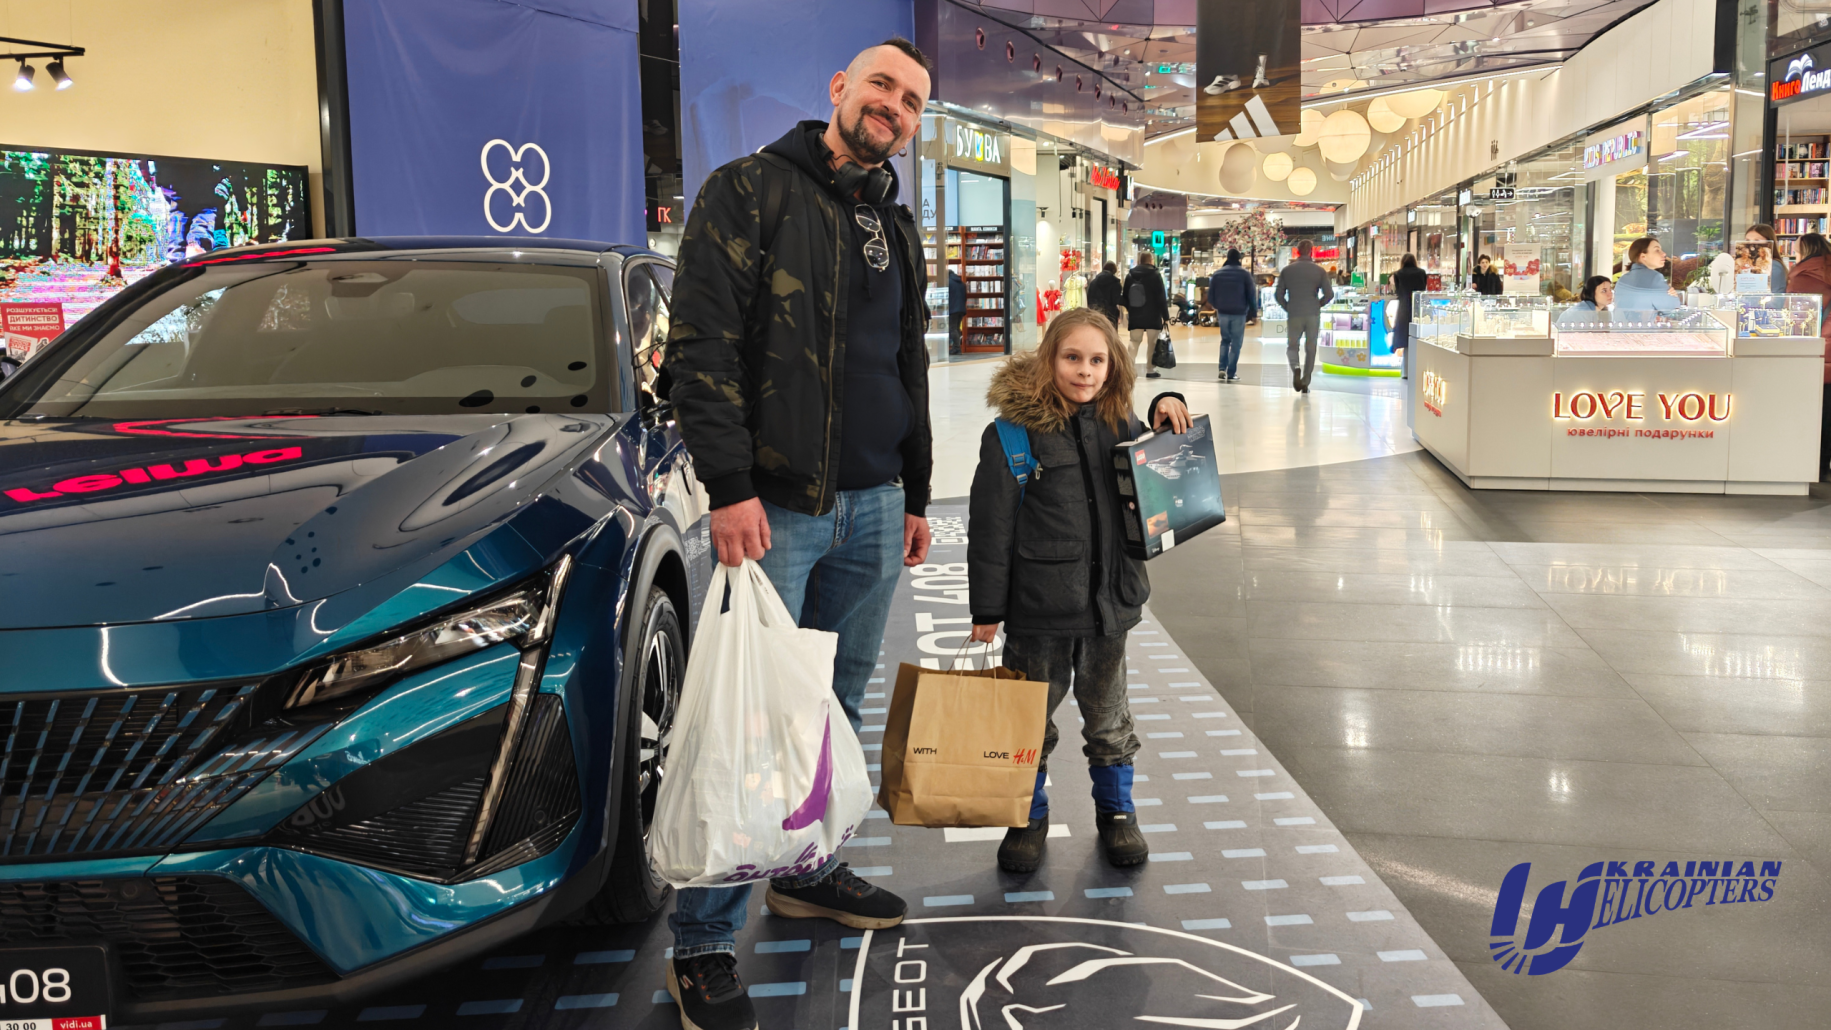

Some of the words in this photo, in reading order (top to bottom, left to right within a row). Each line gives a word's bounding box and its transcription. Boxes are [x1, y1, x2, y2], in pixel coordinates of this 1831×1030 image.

[956, 124, 1001, 164] БУКВА
[9, 315, 58, 323] ДИТИНСТВО
[1553, 391, 1646, 420] LOVE
[1657, 392, 1732, 422] YOU
[1567, 427, 1630, 440] ювелірні
[1634, 428, 1714, 441] подарунки
[913, 747, 938, 756] WITH
[983, 751, 1010, 760] LOVE
[0, 967, 72, 1004] 08
[59, 1020, 93, 1029] vidi.ua
